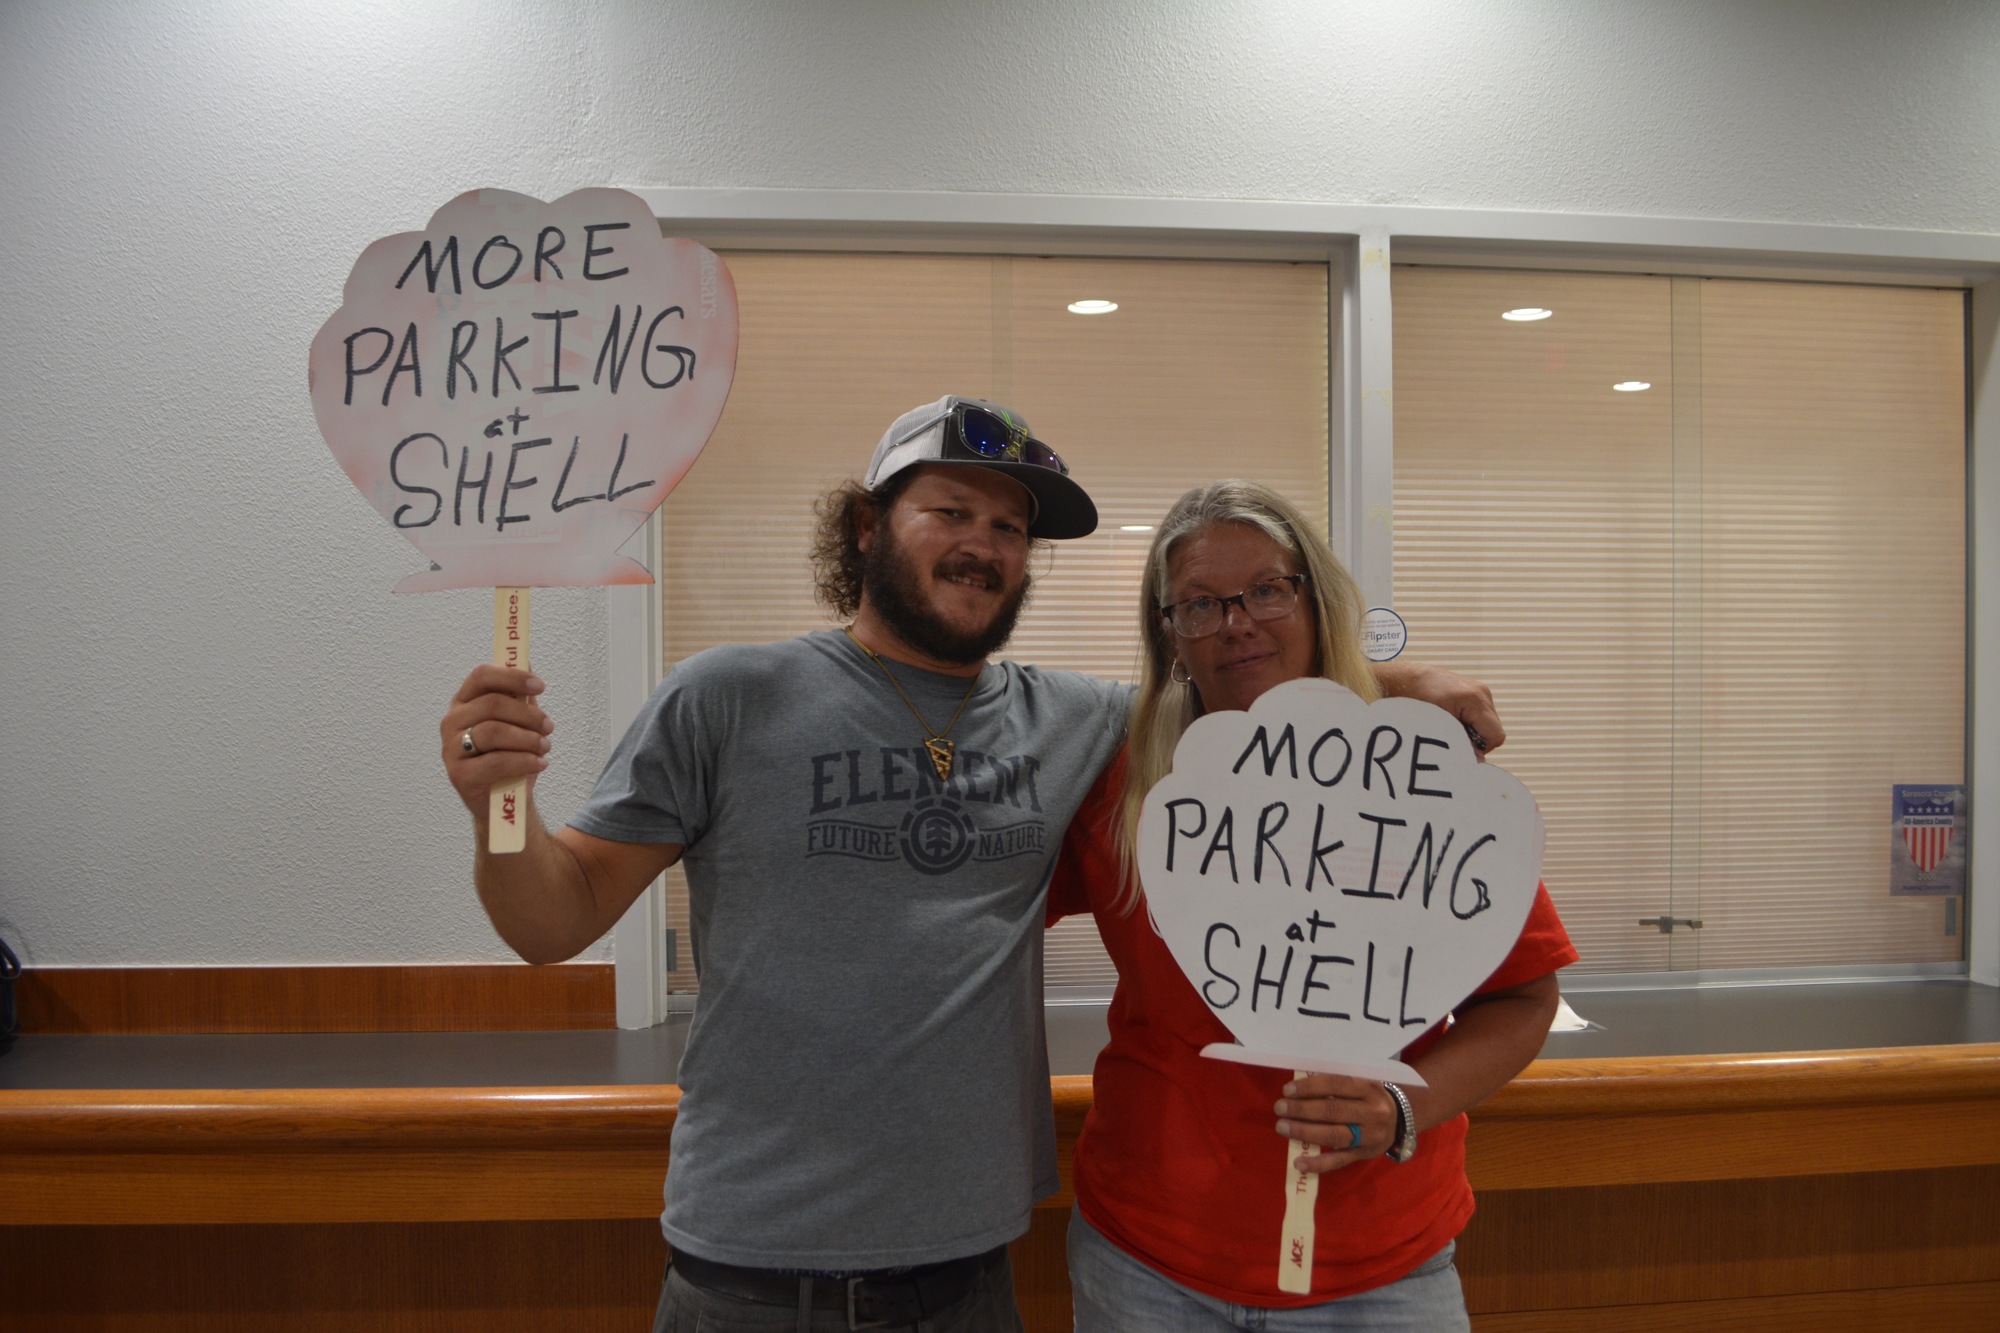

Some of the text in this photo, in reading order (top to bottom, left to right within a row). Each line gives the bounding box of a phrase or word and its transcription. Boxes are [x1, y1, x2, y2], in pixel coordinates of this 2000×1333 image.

[395, 222, 631, 295] MORE
[343, 304, 697, 406] PARKING
[483, 407, 530, 438] at
[390, 432, 656, 532] SHELL
[506, 590, 520, 640] place.
[1365, 631, 1401, 643] Flipster
[810, 746, 1043, 816] ELEMENT
[1232, 723, 1453, 799] MORE
[501, 793, 515, 826] ACE
[807, 824, 1045, 857] FUTURE NATURE
[1165, 798, 1496, 920] PARKING
[1285, 910, 1336, 943] at
[1202, 922, 1427, 1028] SHELL
